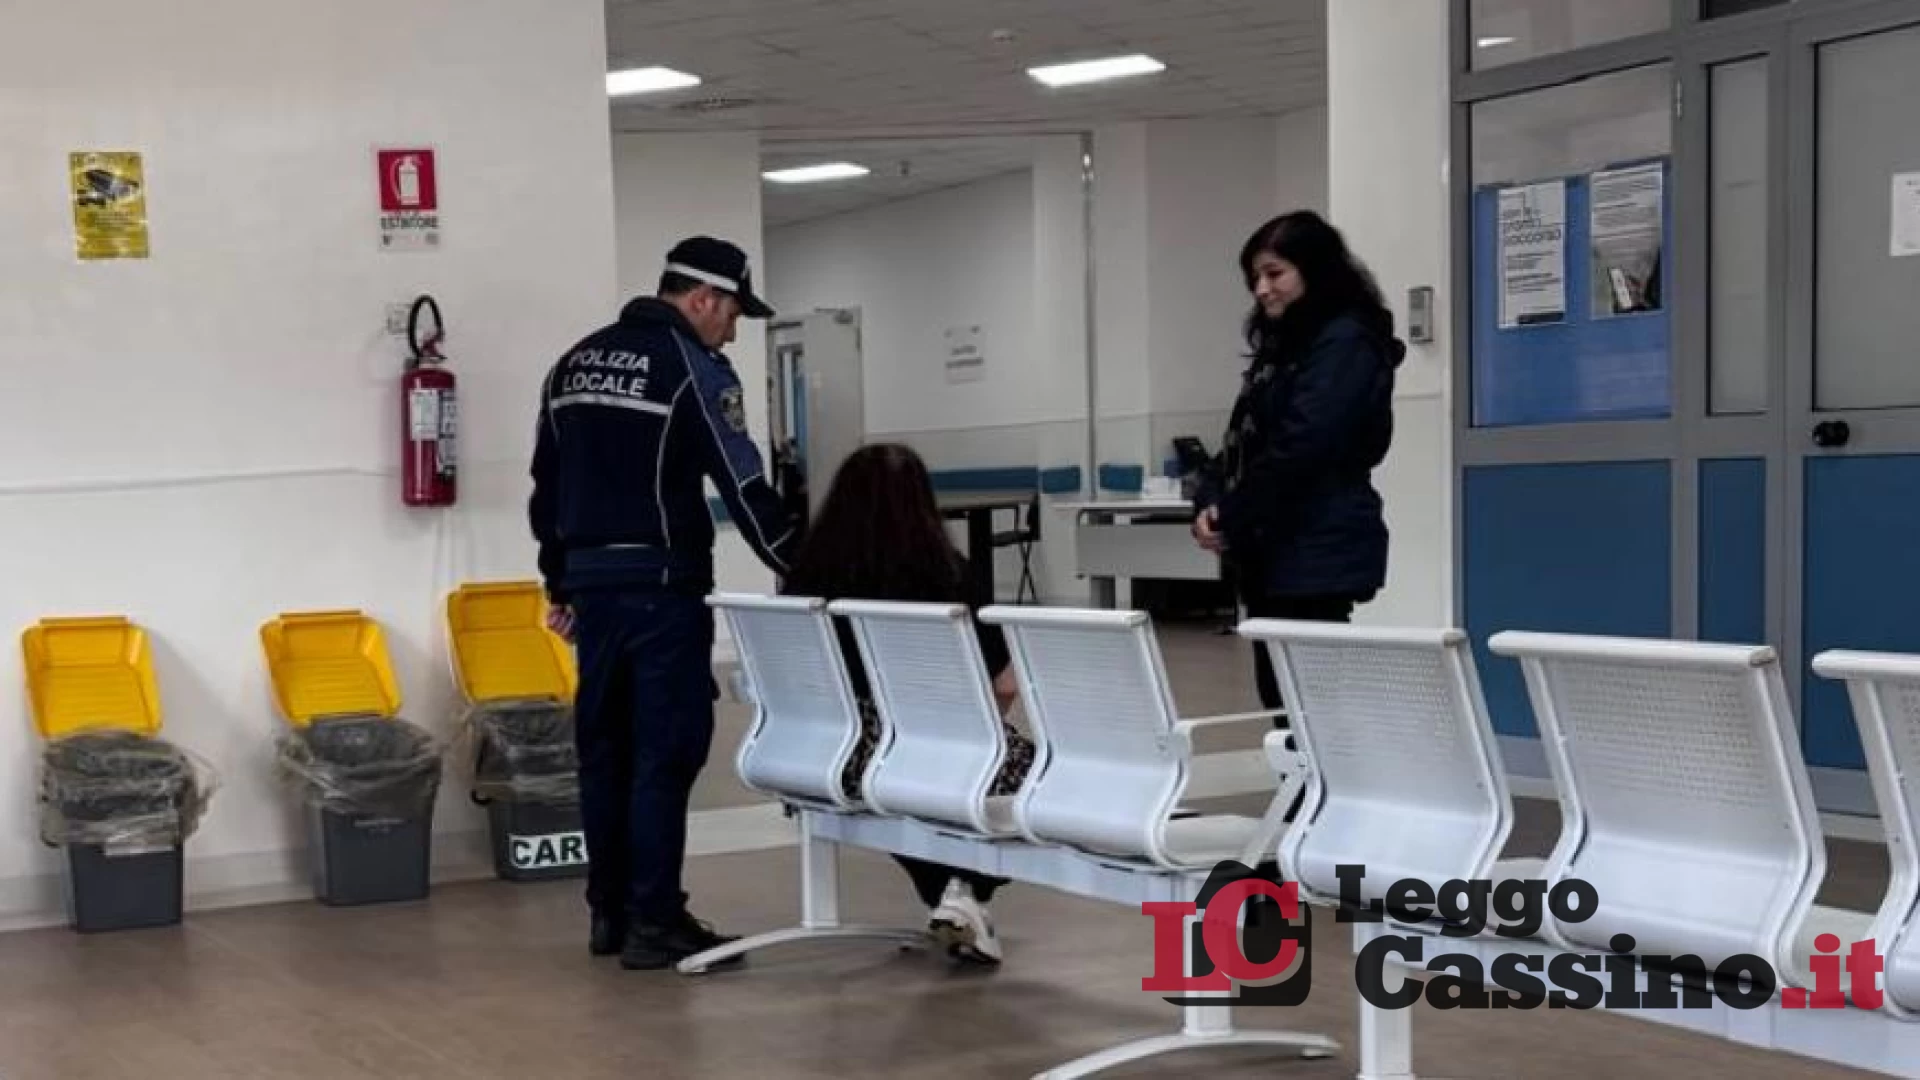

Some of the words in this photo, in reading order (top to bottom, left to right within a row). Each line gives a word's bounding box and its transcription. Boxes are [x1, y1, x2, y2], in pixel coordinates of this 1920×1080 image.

[568, 348, 650, 373] POLIZIA
[562, 372, 648, 398] LOCALE
[511, 836, 584, 865] CAR
